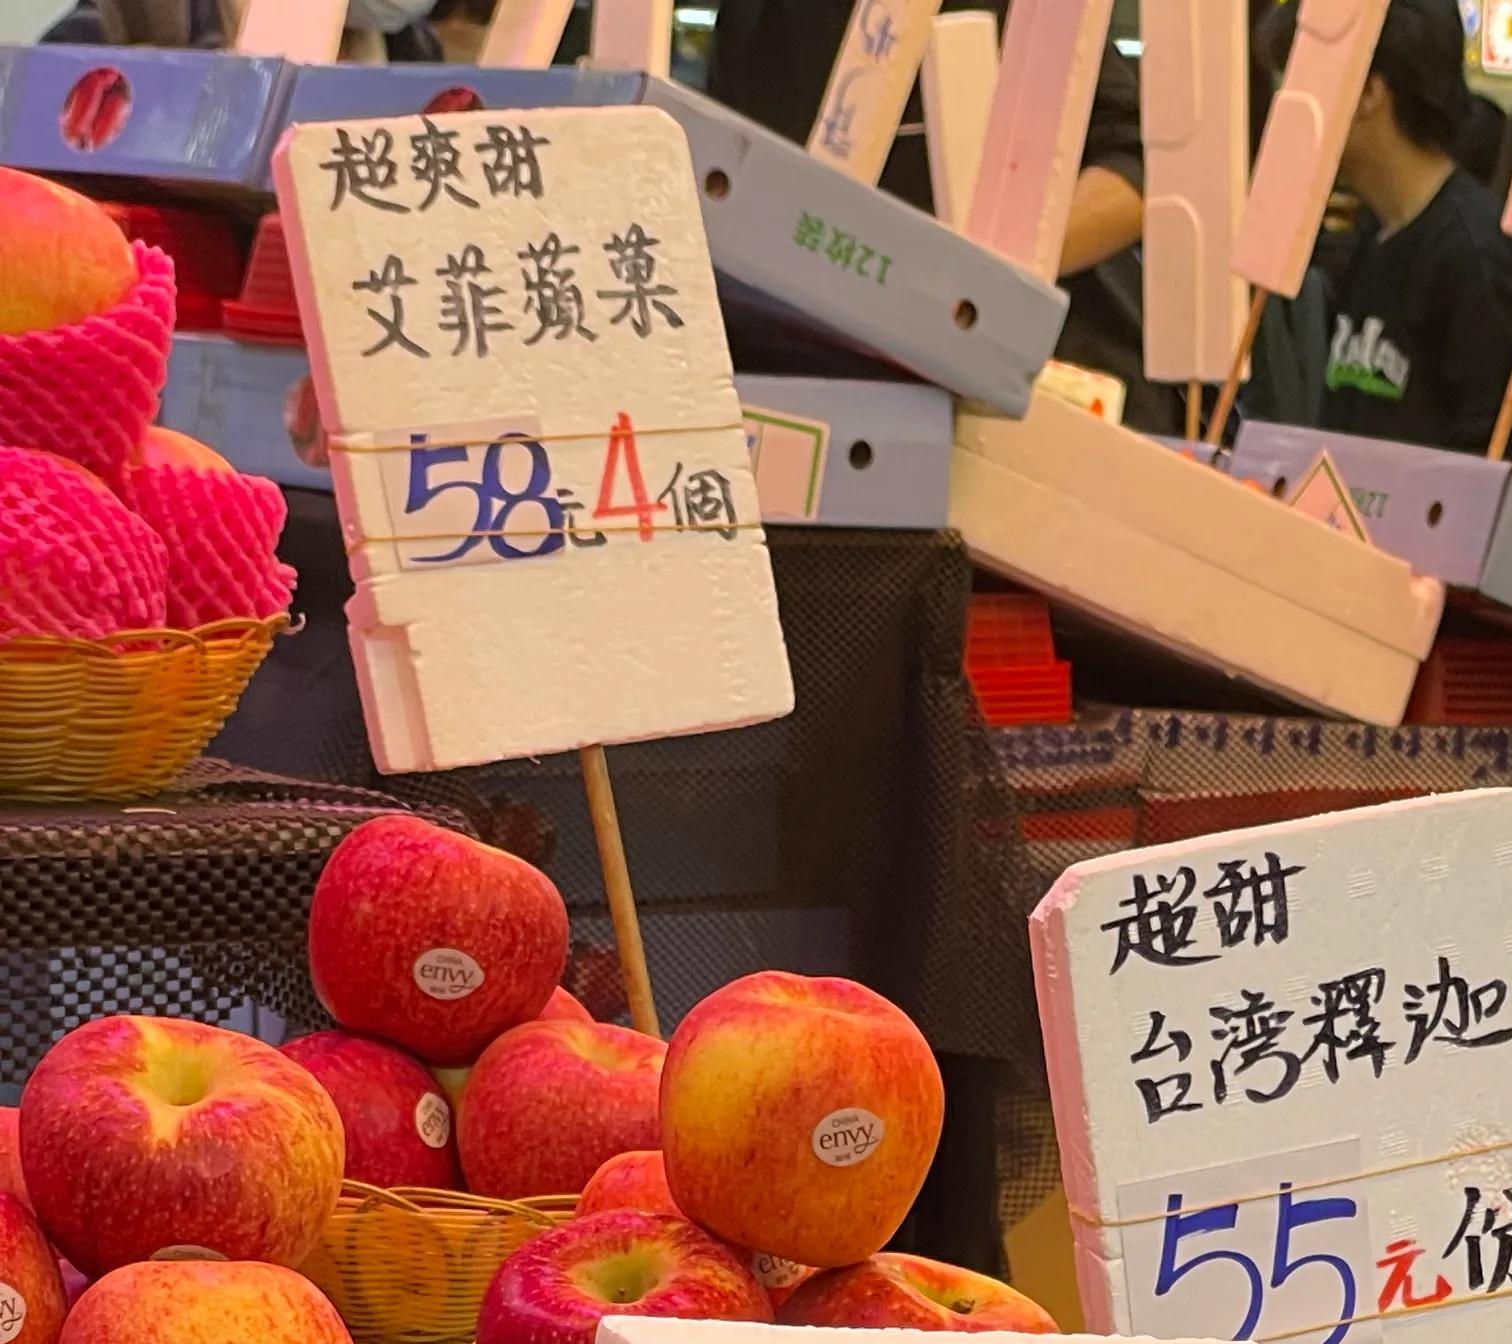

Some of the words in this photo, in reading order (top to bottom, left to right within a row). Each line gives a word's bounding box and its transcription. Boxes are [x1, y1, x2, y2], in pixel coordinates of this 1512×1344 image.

[320, 116, 550, 215] 超爽甜
[1101, 851, 1306, 976] 超甜
[420, 963, 474, 993] envy
[819, 1123, 879, 1154] envy
